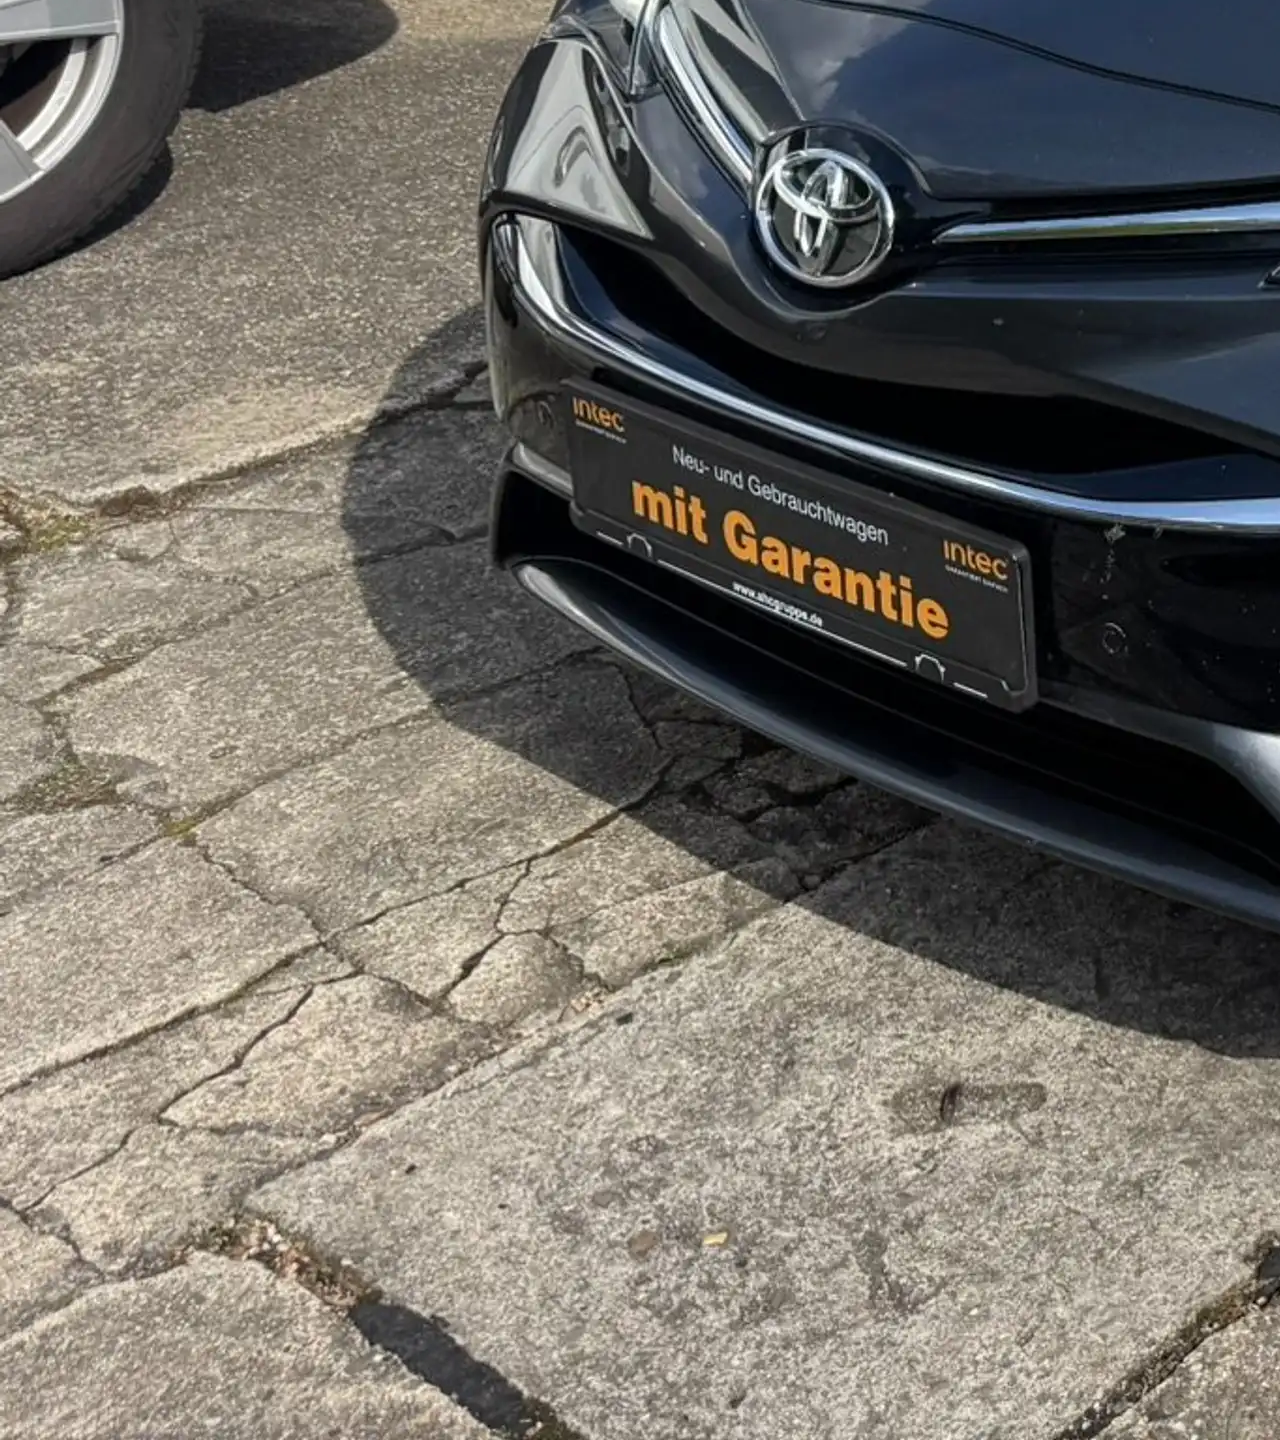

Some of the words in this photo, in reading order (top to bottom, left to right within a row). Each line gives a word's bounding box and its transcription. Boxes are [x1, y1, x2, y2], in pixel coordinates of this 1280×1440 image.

[631, 480, 709, 545] mit
[722, 509, 950, 640] Garantie
[672, 444, 711, 476] Neu-
[714, 462, 744, 492] und
[747, 474, 889, 547] Gebrauchtwagen
